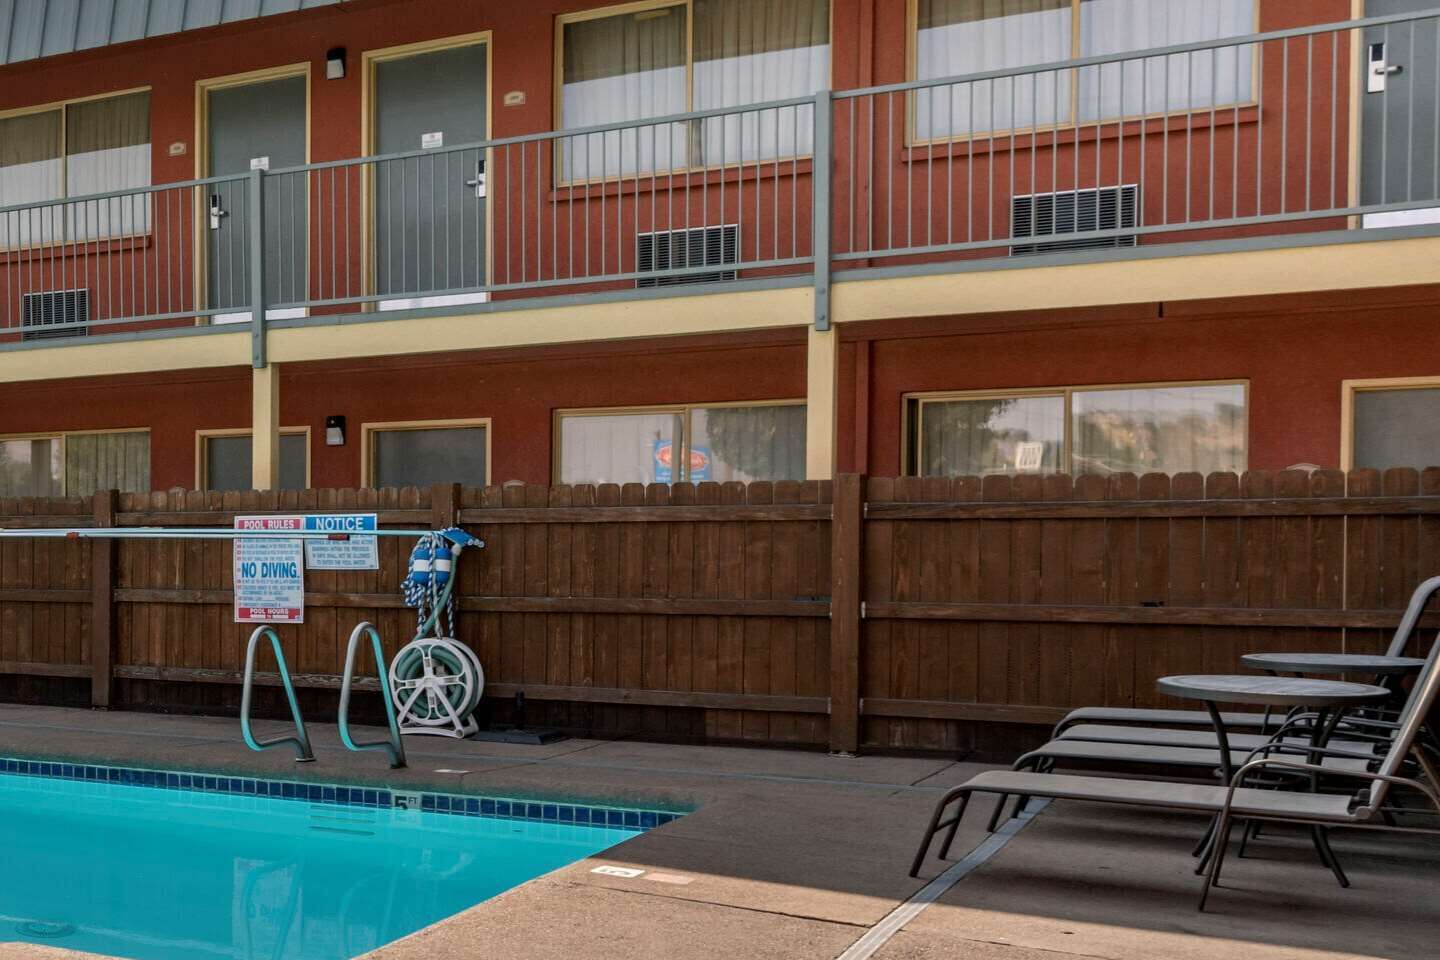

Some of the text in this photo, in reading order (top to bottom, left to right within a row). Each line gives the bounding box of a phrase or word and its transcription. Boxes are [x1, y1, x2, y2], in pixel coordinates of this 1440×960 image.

[244, 520, 295, 529] POOL RULES
[316, 517, 364, 530] NOTICE
[242, 562, 257, 578] NO
[395, 796, 408, 809] 5
